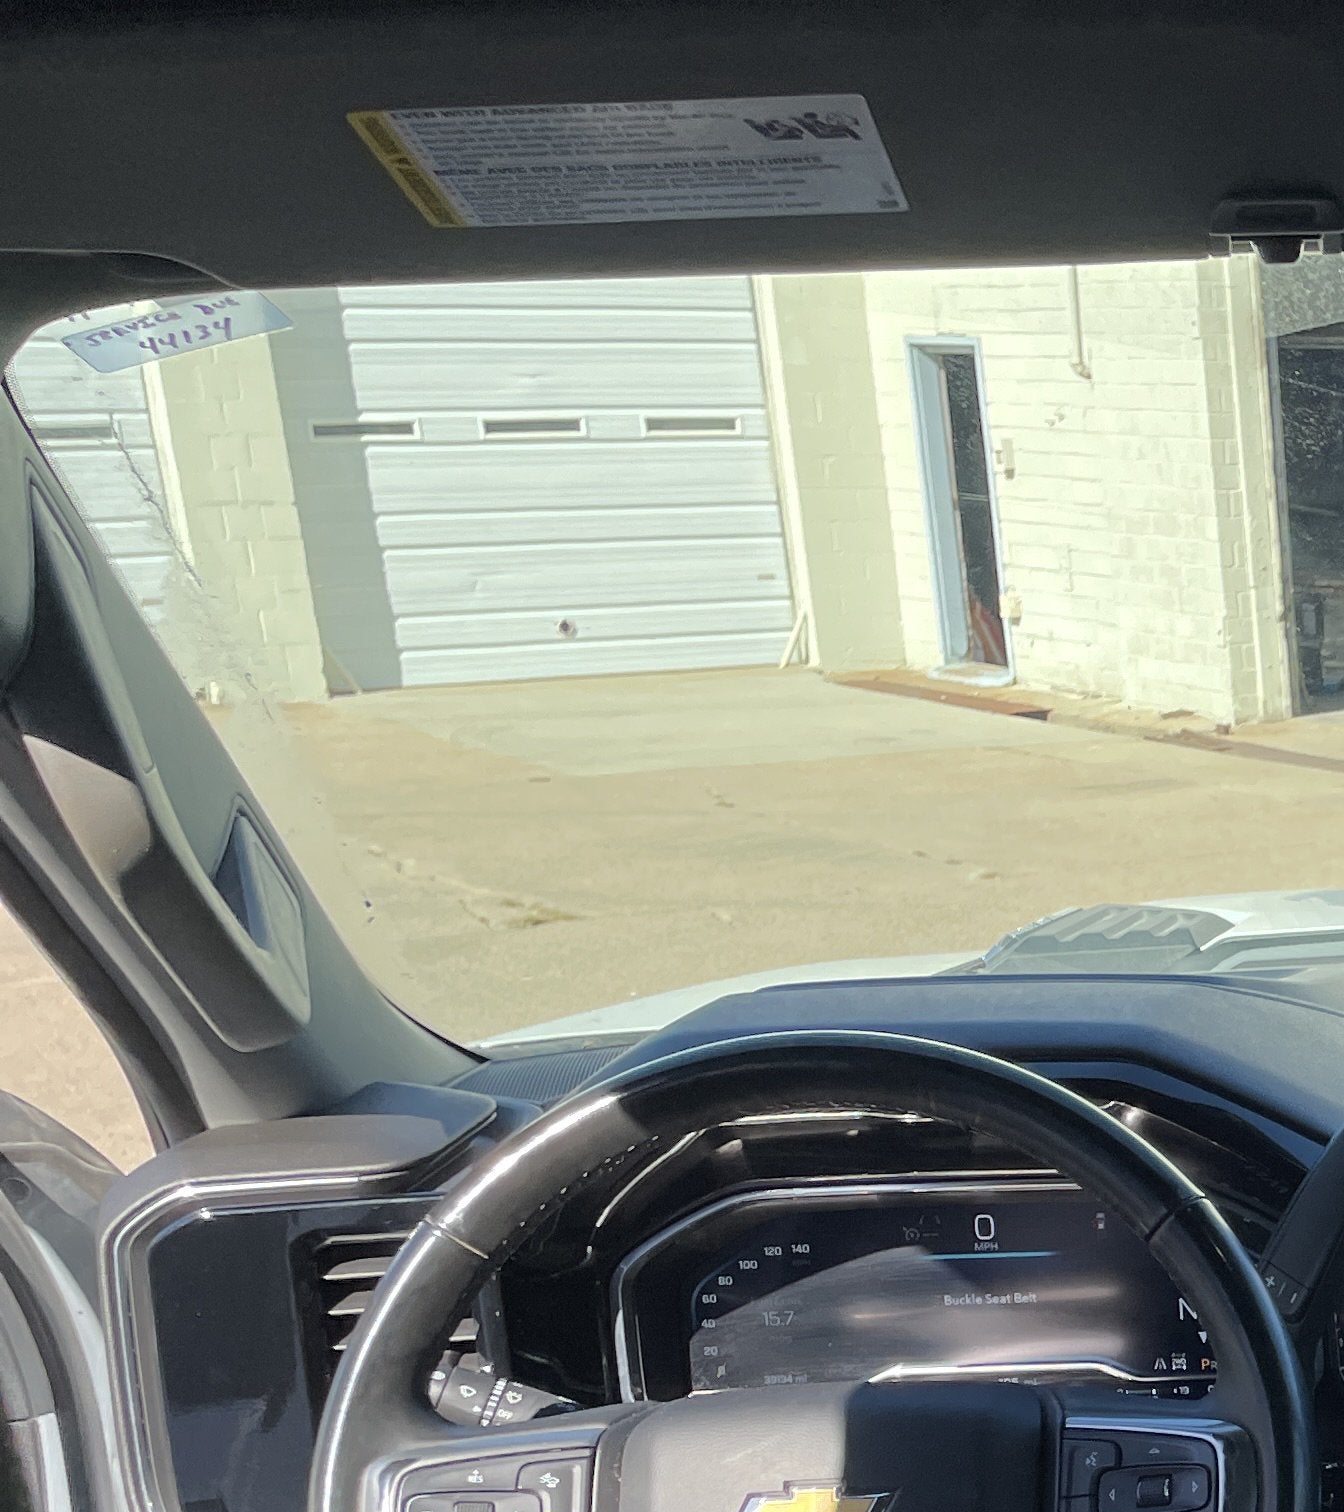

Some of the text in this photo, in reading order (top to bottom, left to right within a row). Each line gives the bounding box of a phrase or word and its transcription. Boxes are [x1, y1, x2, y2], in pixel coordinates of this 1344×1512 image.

[193, 296, 241, 316] DUE
[139, 316, 233, 355] 44134
[974, 1213, 995, 1241] 0
[763, 1245, 782, 1256] 120
[791, 1243, 810, 1254] 140
[973, 1241, 999, 1252] MPH
[738, 1260, 758, 1270] 100
[717, 1275, 733, 1286] 80
[702, 1293, 717, 1304] 60
[943, 1291, 1038, 1306] Buckle Seat Belt
[701, 1318, 716, 1329] 40
[762, 1310, 795, 1327] 15.7
[703, 1345, 719, 1356] 20
